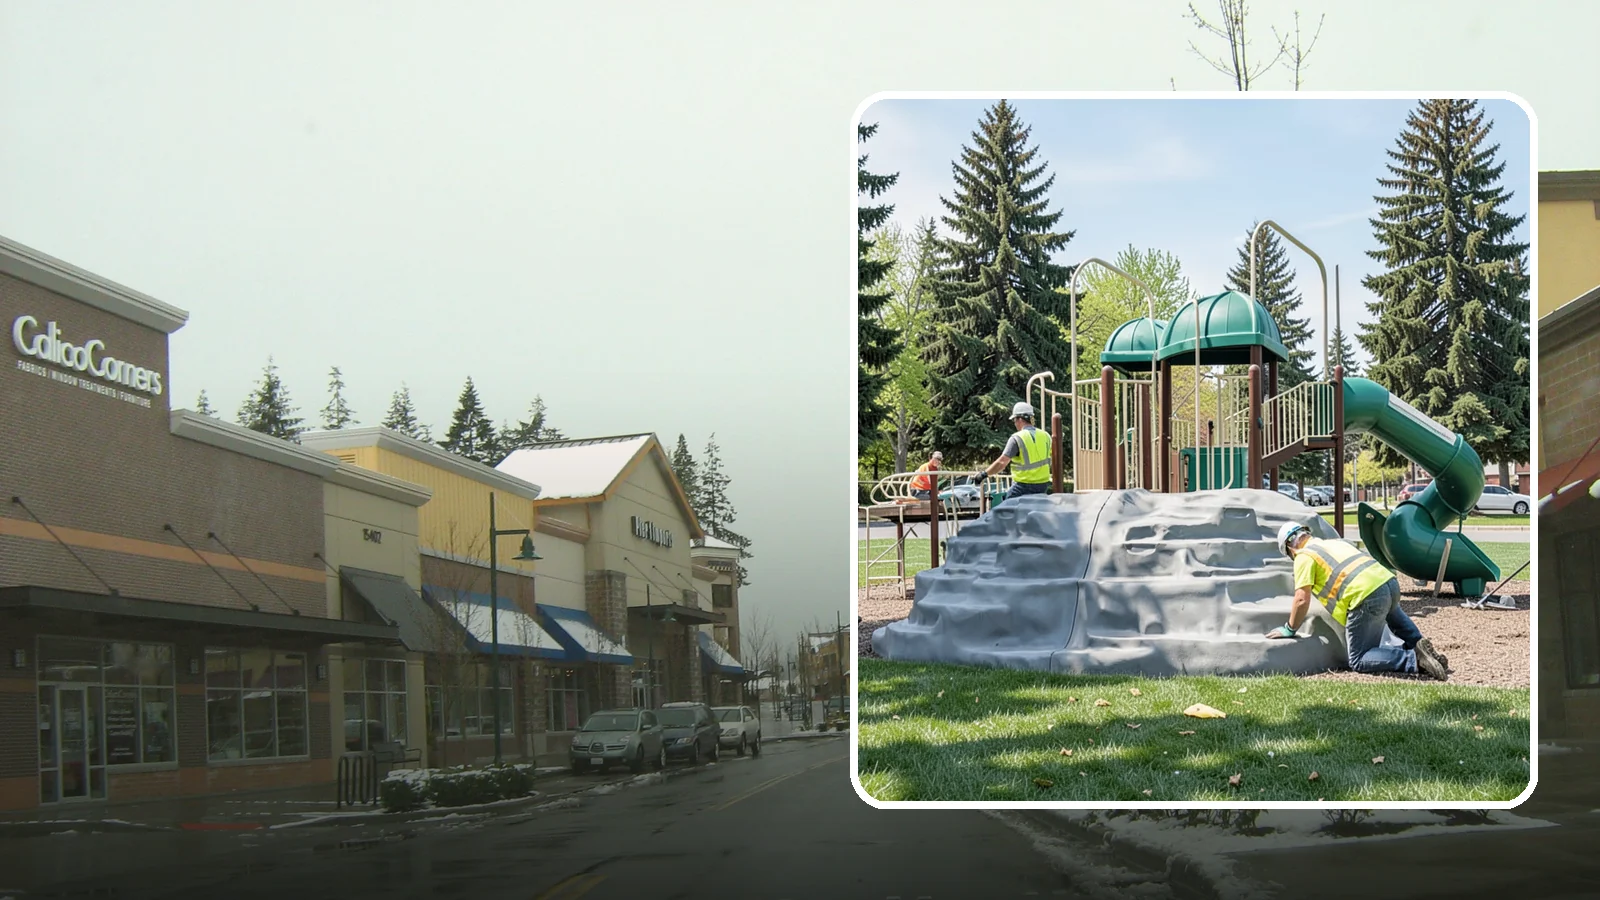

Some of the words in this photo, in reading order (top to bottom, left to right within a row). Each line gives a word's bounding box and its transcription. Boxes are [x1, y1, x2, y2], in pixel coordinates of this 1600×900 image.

[17, 360, 47, 378] FABRICS
[51, 370, 78, 386] WINDOW
[79, 378, 117, 398] TREATMENTS
[120, 391, 151, 408] FURNITURE
